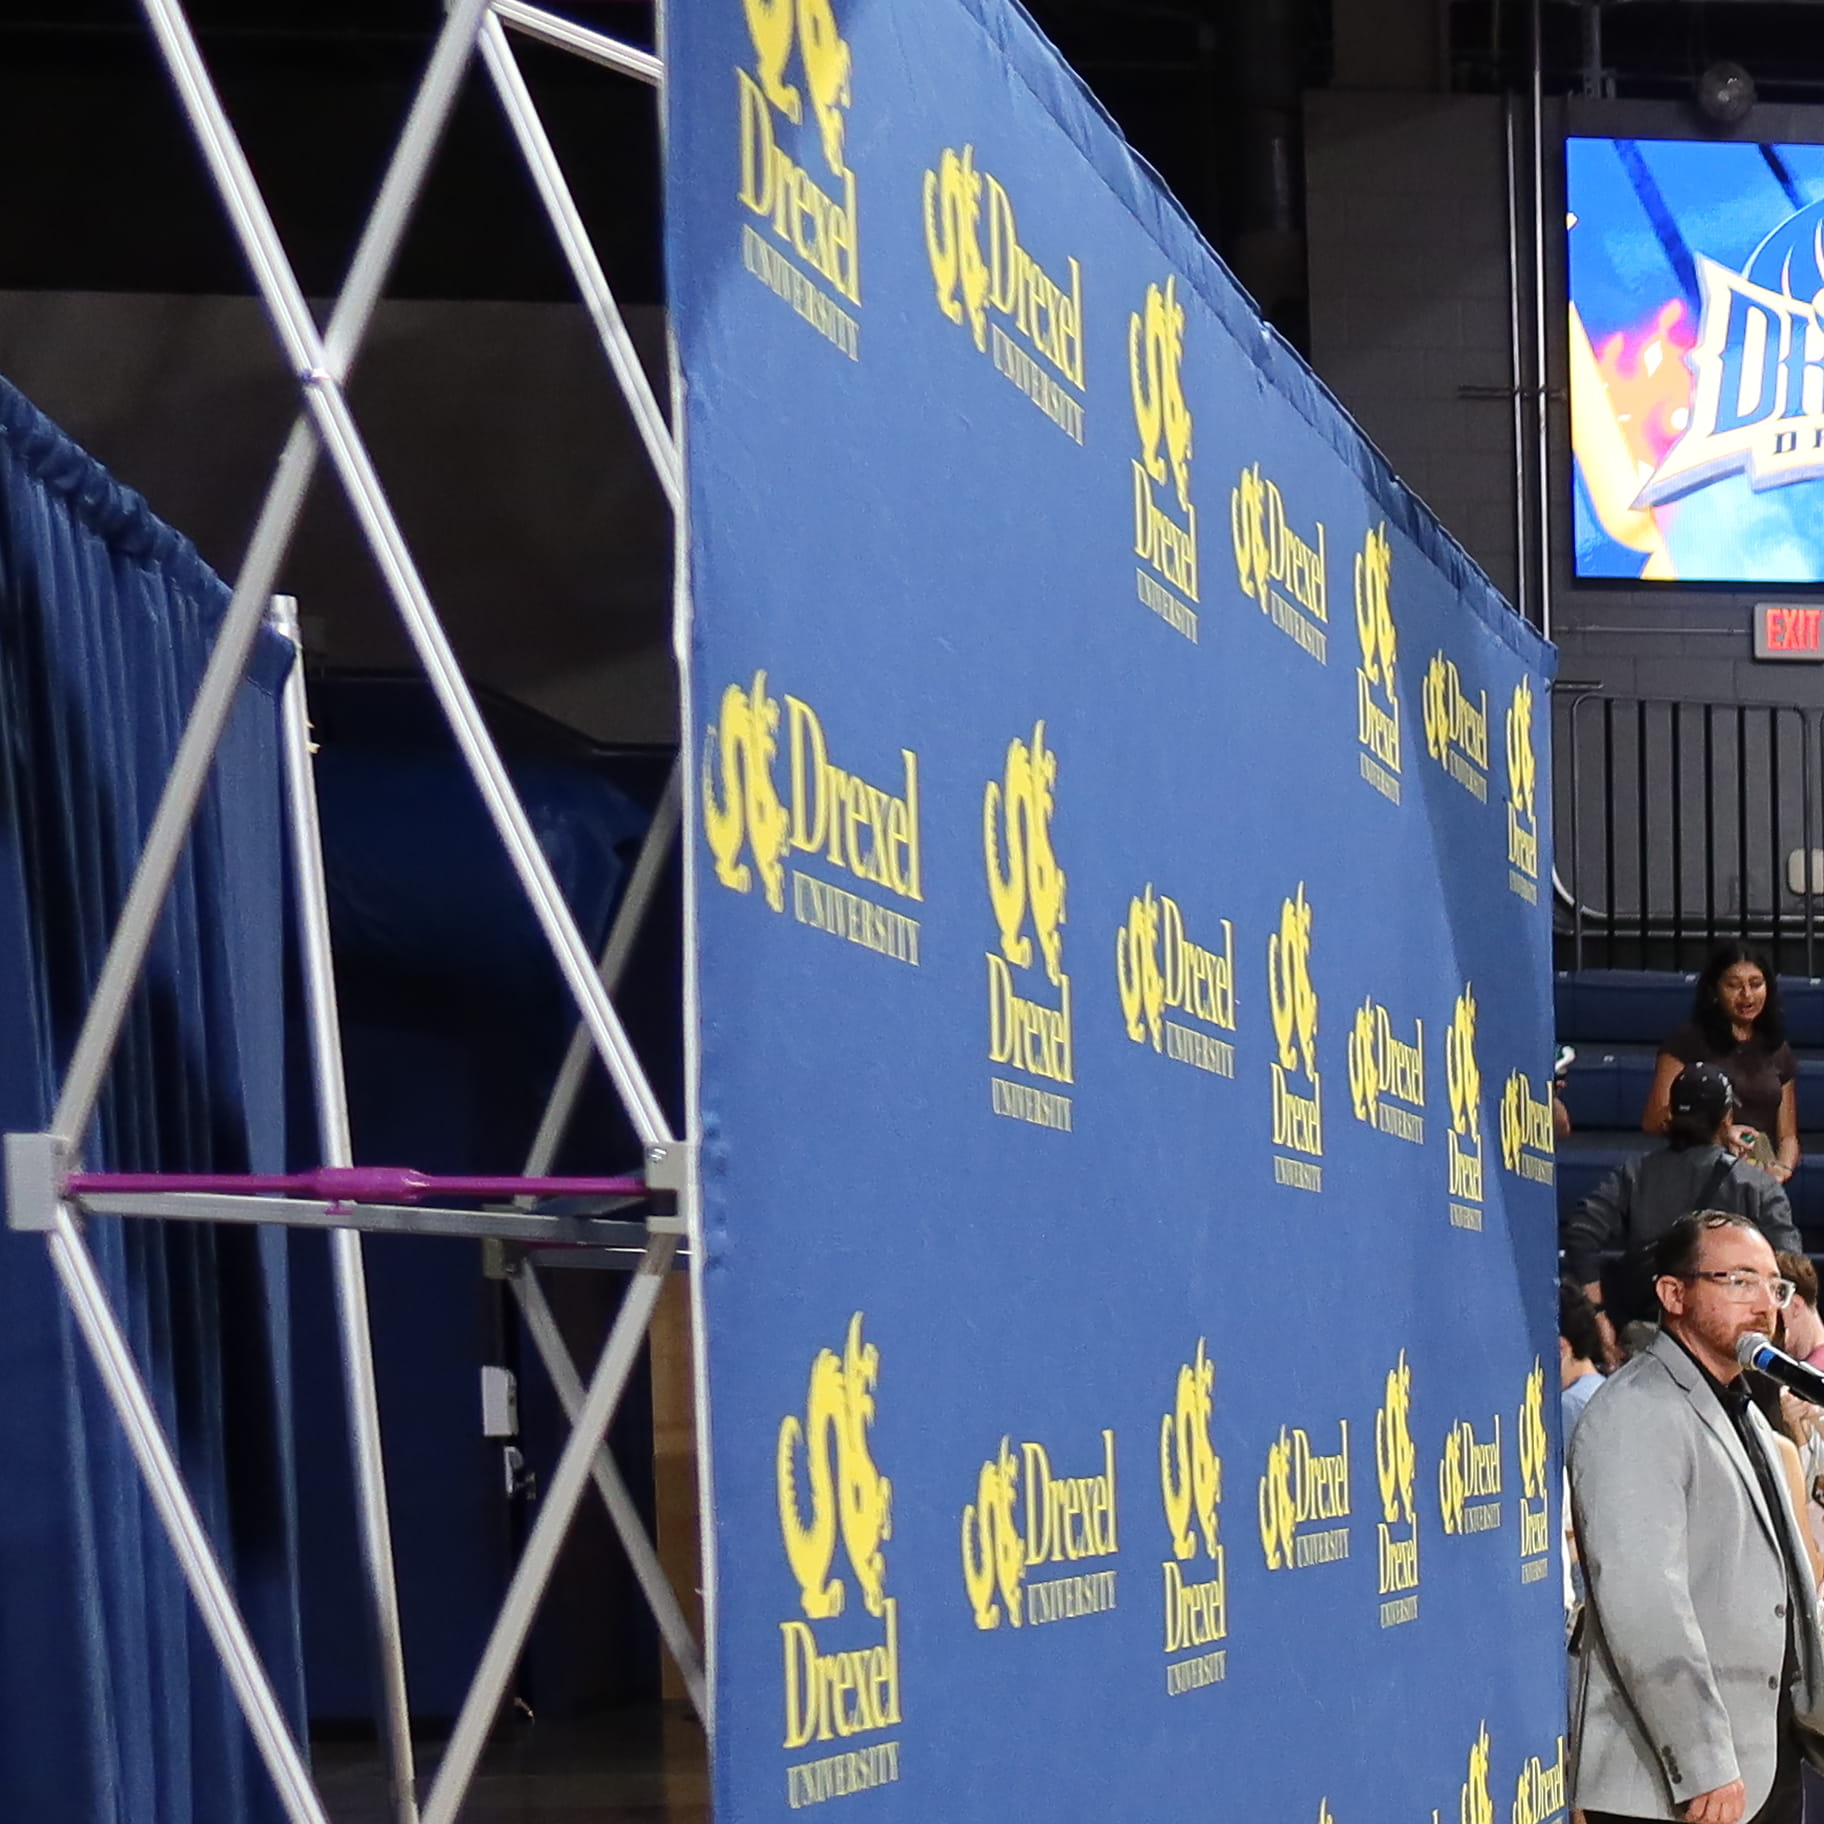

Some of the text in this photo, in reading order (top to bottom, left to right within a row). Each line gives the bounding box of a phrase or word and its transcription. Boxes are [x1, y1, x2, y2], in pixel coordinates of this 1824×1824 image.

[736, 66, 862, 307] Drexel
[743, 224, 859, 361] UNIVERSITY
[985, 172, 1085, 391] Drexel
[992, 322, 1085, 446] UNIVERSITY
[1131, 459, 1199, 602] Drexel
[1265, 480, 1328, 623] Drexel
[1136, 568, 1198, 644] UNIVERSITY
[1270, 590, 1327, 665] UNIVERSITY
[1766, 608, 1823, 651] EXIT
[1356, 667, 1401, 773] Drexel
[1446, 660, 1488, 770] Drexel
[784, 694, 924, 902] Drexel
[1508, 802, 1537, 878] Drexel
[793, 870, 920, 966] UNIVERSITY
[1161, 896, 1236, 1030] Drexel
[985, 953, 1074, 1083] Drexel
[1166, 1020, 1235, 1079] UNIVERSITY
[1376, 1004, 1424, 1106] Drexel
[992, 1077, 1072, 1132] UNIVERSITY
[1270, 1062, 1323, 1155] Drexel
[1378, 1102, 1424, 1144] UNIVERSITY
[1519, 1073, 1554, 1153] Drexel
[1273, 1155, 1322, 1192] UNIVERSITY
[1448, 1128, 1483, 1202] Drexel
[1022, 1429, 1119, 1566] Drexel
[1293, 1419, 1351, 1522] Drexel
[1461, 1414, 1501, 1497] Drexel
[1296, 1528, 1349, 1568] UNIVERSITY
[1378, 1512, 1419, 1594] Drexel
[1520, 1489, 1549, 1557] Drexel
[1028, 1570, 1118, 1626] UNIVERSITY
[1162, 1545, 1228, 1653] Drexel
[780, 1598, 901, 1748] Drexel
[1166, 1650, 1227, 1696] UNIVERSITY
[787, 1742, 899, 1809] UNIVERSITY
[1531, 1736, 1565, 1824] Drexel
